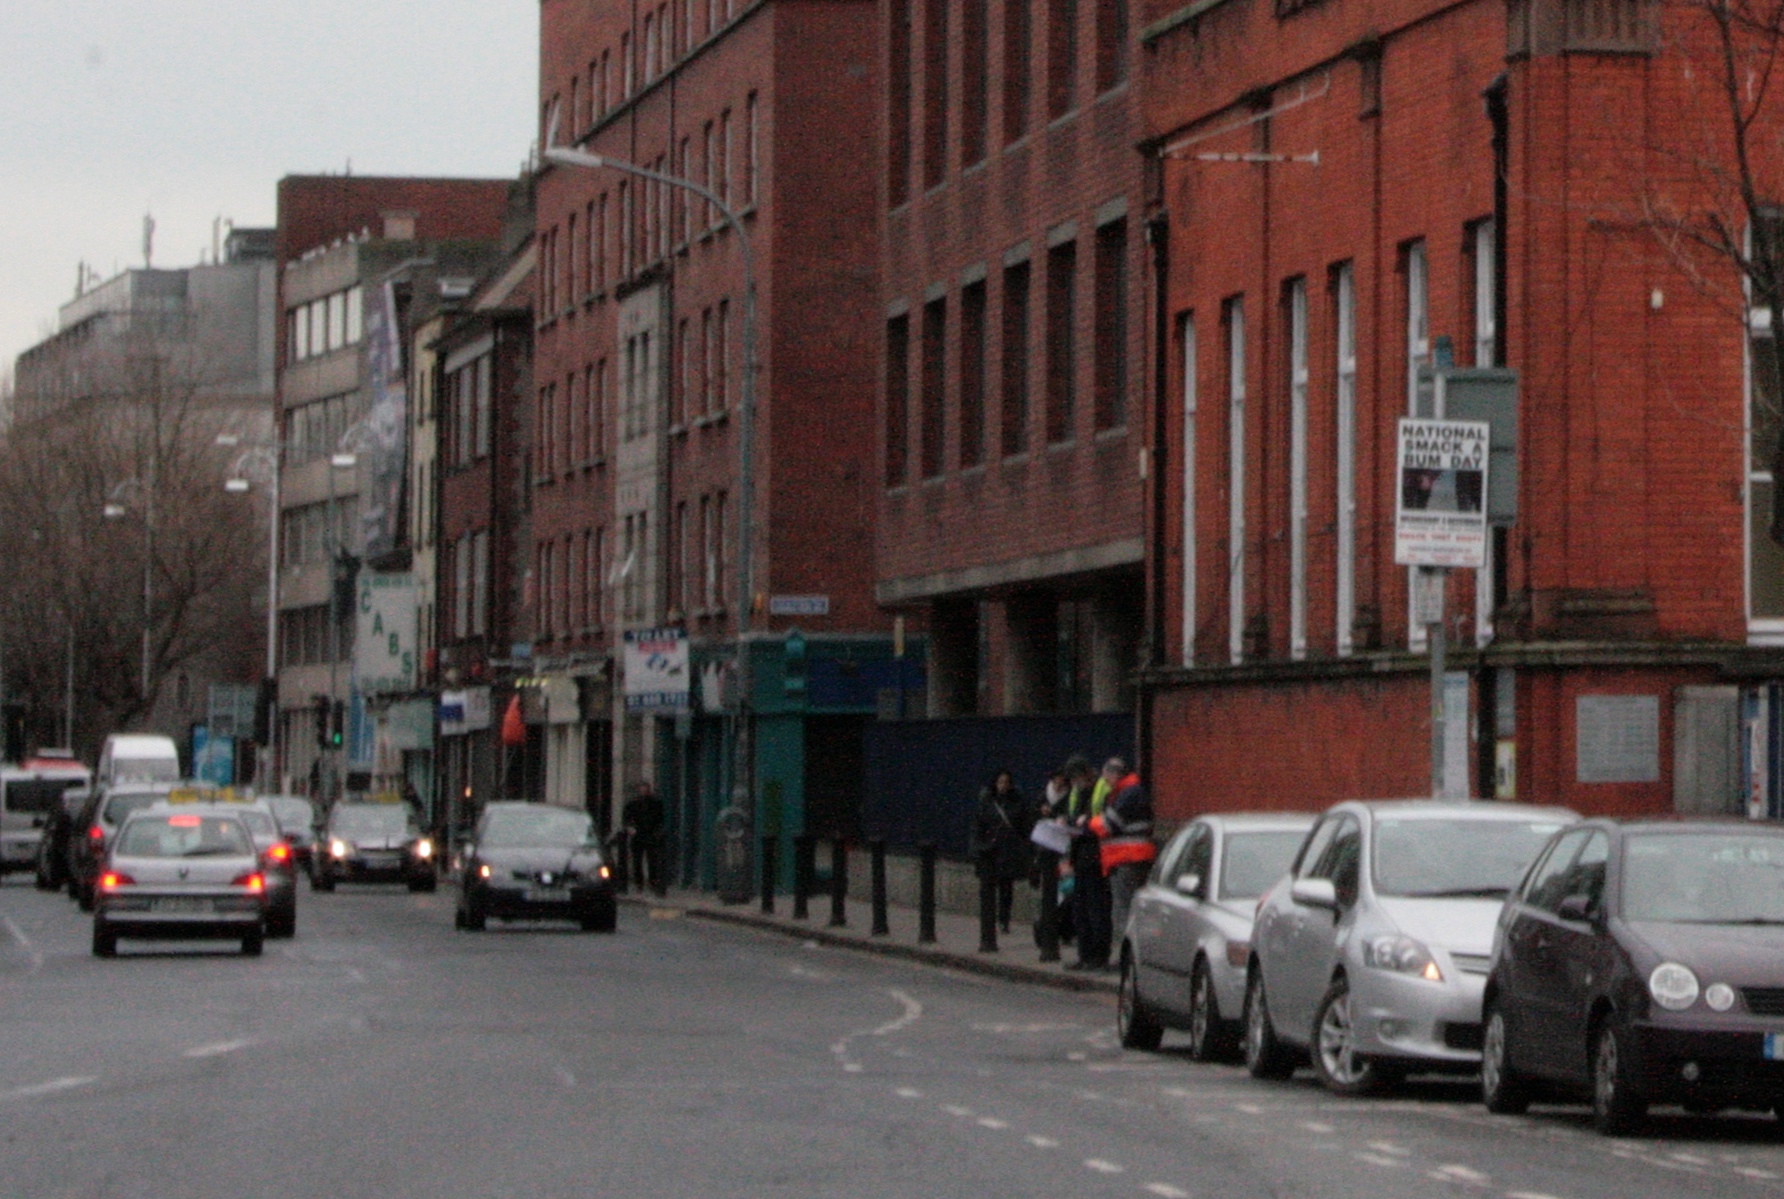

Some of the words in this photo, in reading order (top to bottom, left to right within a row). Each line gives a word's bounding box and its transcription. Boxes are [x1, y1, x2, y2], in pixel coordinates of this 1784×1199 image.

[1402, 424, 1486, 441] NATIONAL
[1404, 439, 1463, 455] SMACK
[1472, 441, 1483, 455] A
[1404, 453, 1441, 468] BUM
[1450, 454, 1483, 471] DAY
